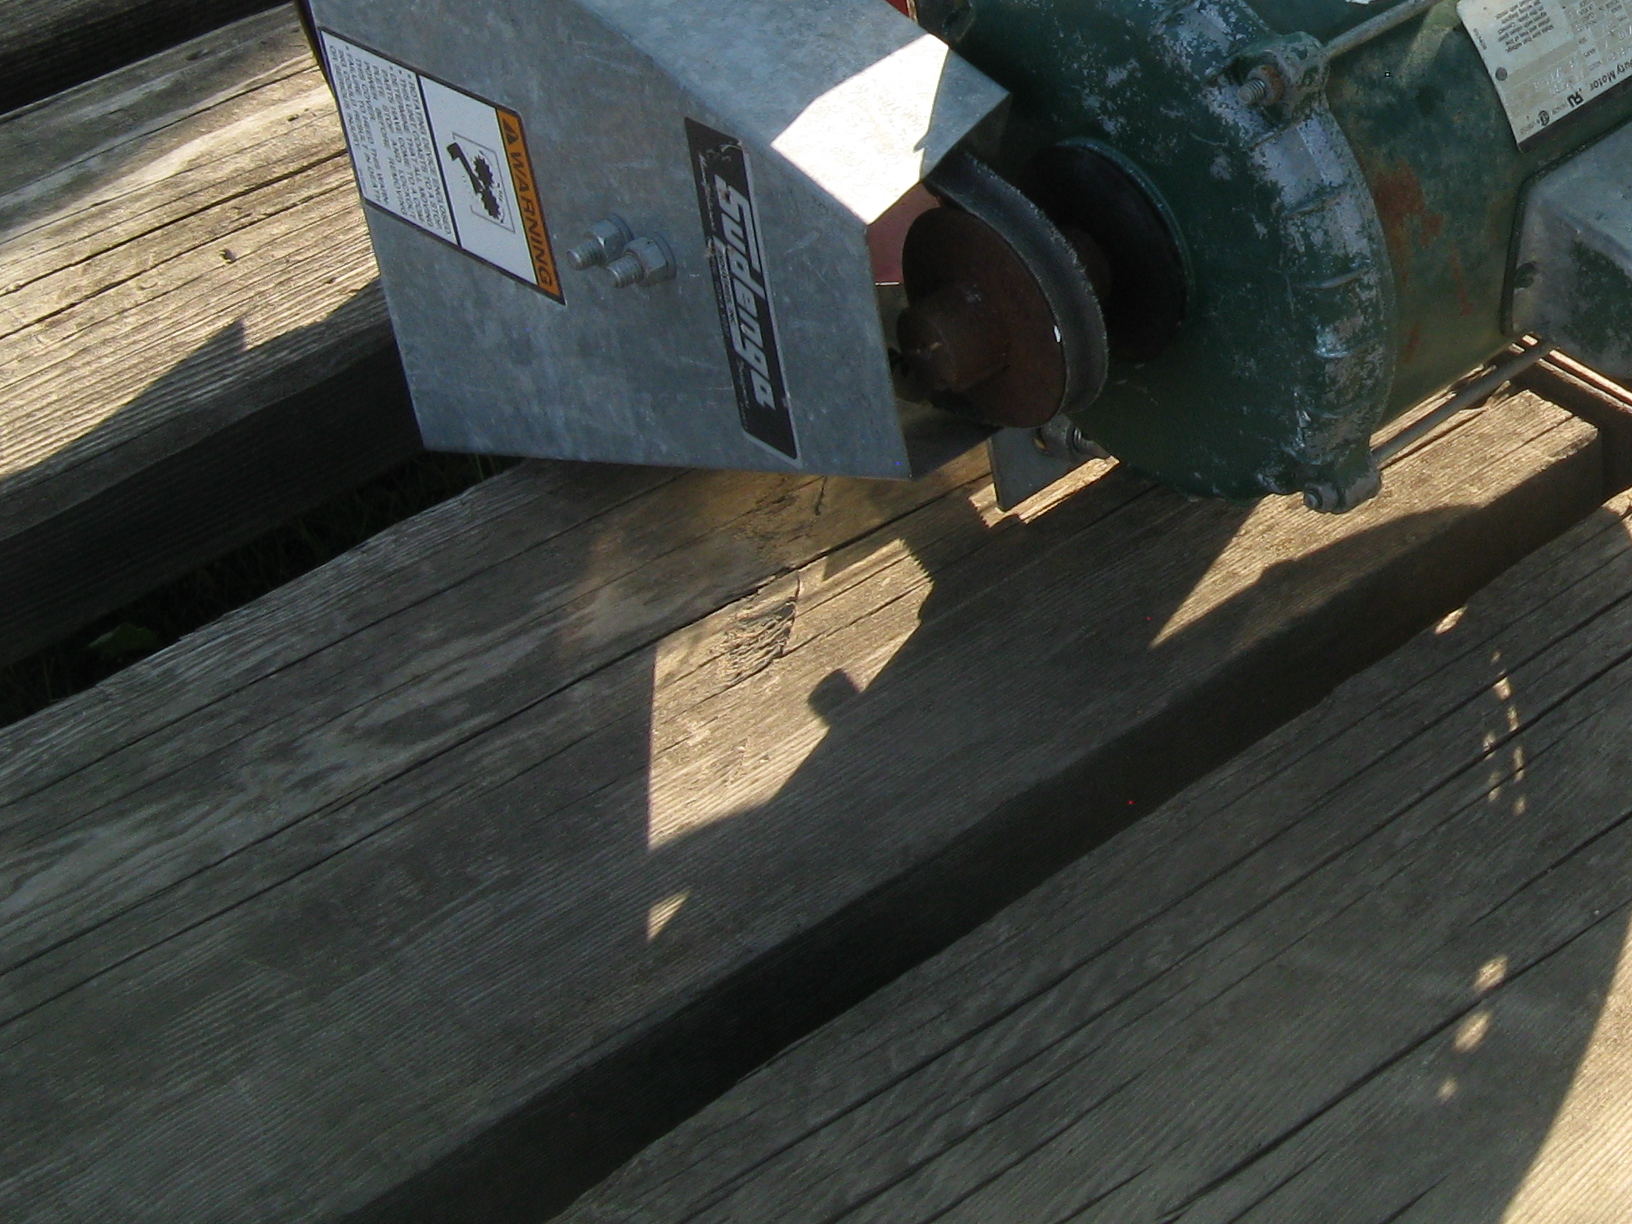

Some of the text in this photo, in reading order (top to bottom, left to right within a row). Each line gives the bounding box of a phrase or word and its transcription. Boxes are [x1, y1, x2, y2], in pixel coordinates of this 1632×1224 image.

[1586, 69, 1618, 94] Motor
[510, 151, 553, 288] WARNING
[710, 174, 776, 411] Sudenga
